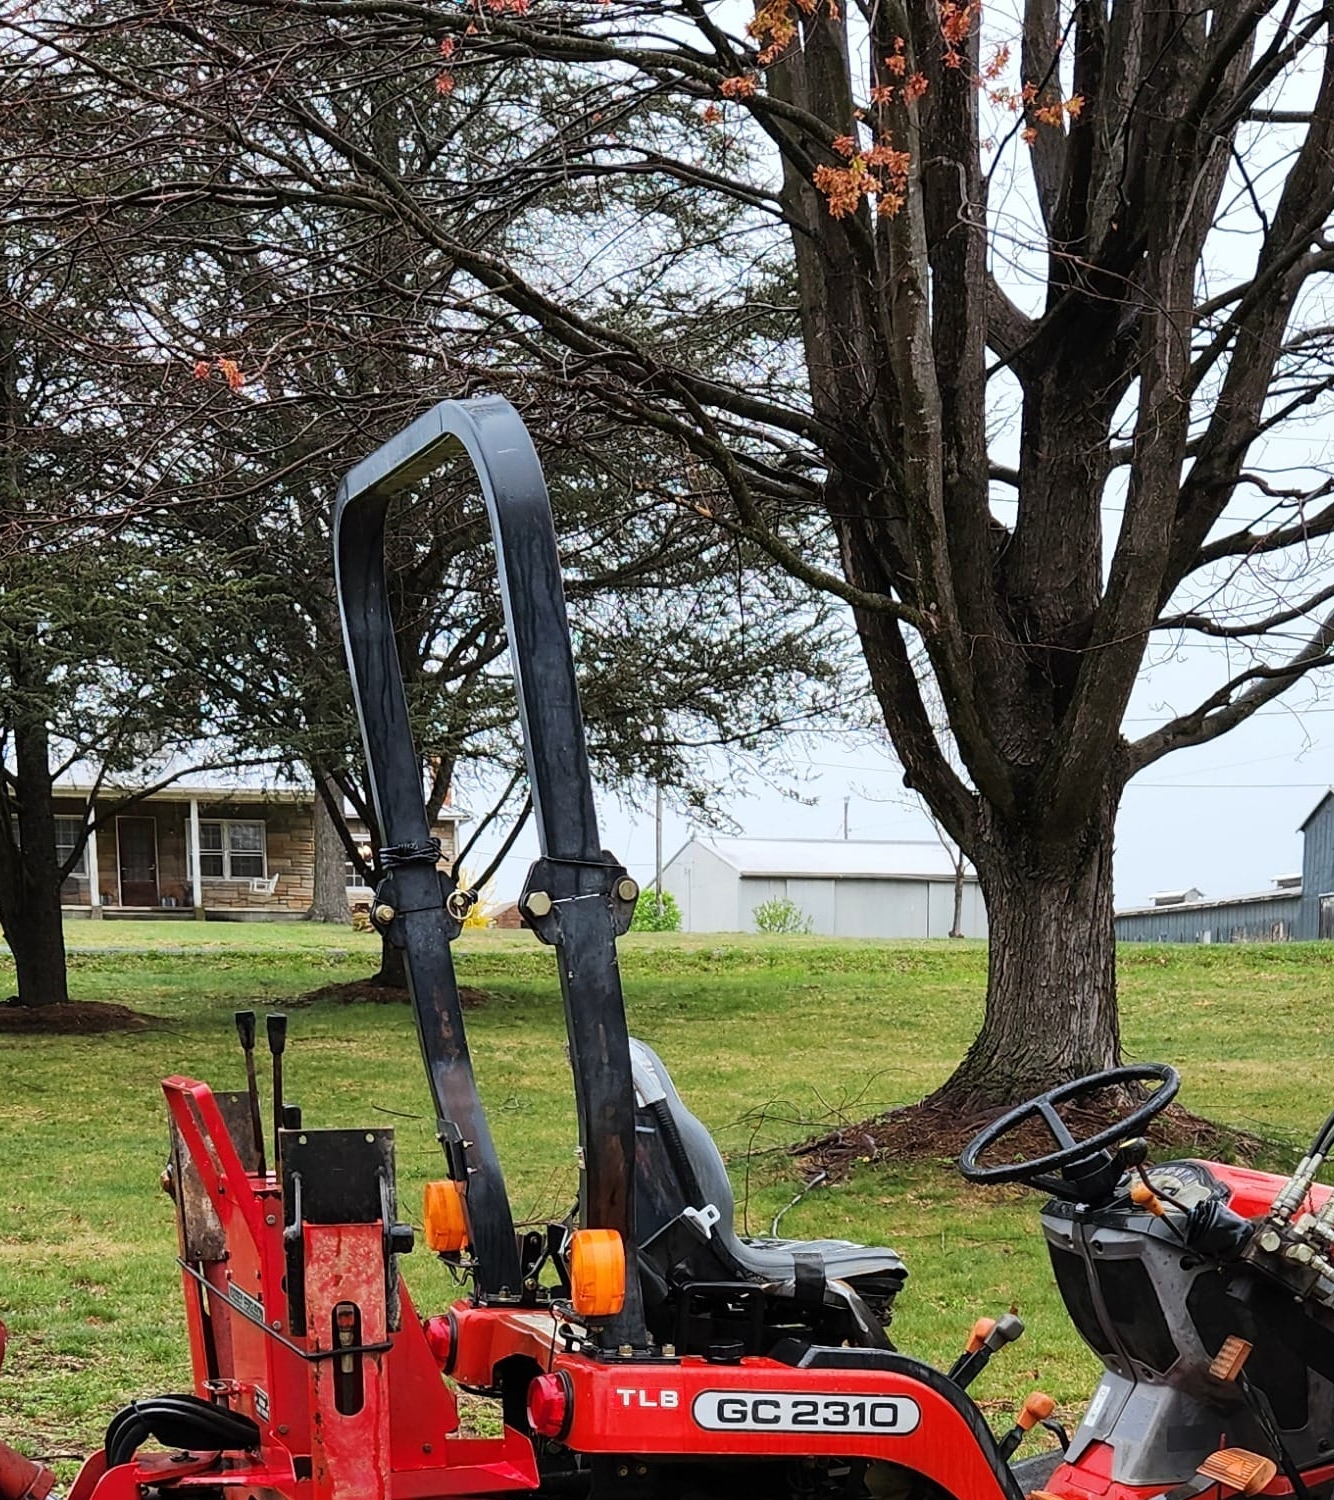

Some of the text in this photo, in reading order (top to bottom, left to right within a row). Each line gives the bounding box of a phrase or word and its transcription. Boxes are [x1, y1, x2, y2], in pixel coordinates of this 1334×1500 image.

[617, 1388, 678, 1408] TLB
[717, 1398, 898, 1427] GC 2310
